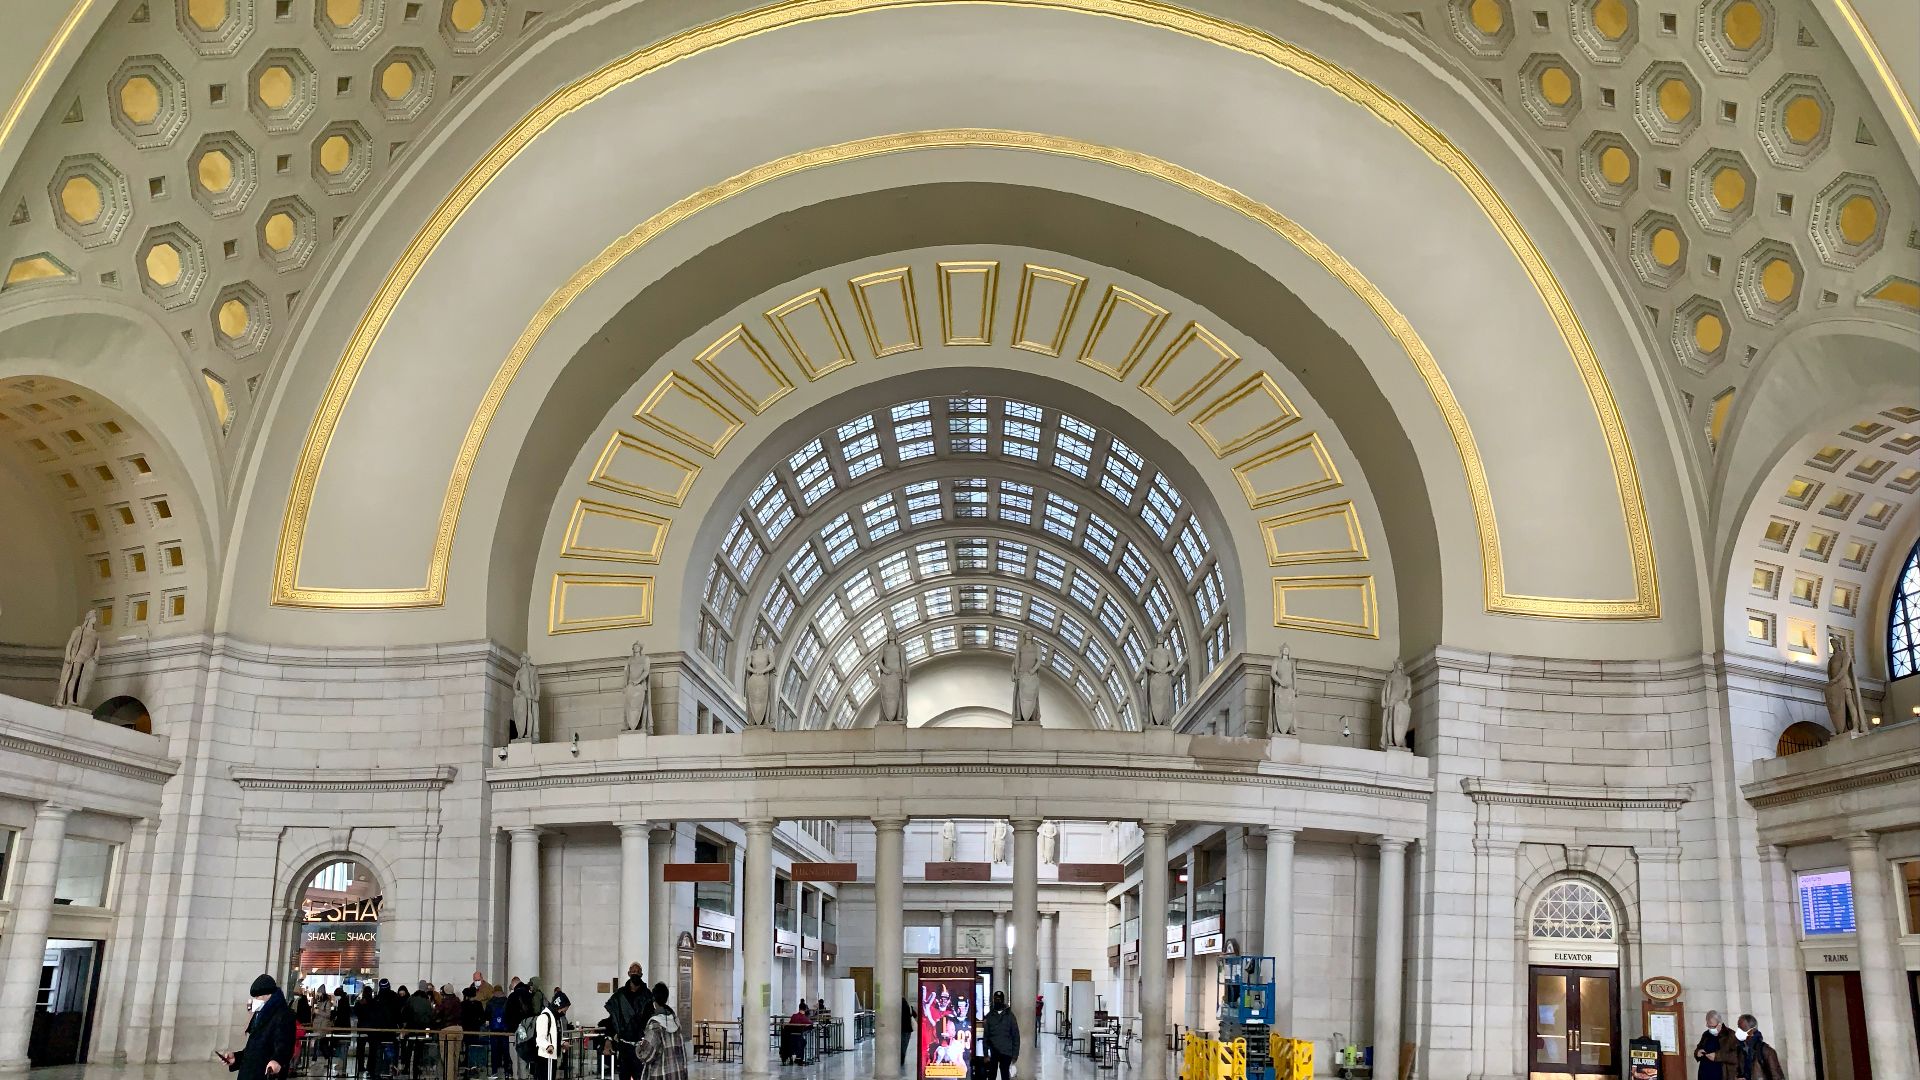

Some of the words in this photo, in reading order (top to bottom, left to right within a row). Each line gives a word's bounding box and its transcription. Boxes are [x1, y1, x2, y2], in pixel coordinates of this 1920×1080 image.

[307, 932, 336, 941] SHAKE
[346, 932, 377, 941] SHACK
[1554, 952, 1592, 961] ELEVATOR
[1823, 954, 1849, 963] TRAINS
[922, 965, 970, 974] DIRECTORY
[1649, 983, 1675, 994] UNO
